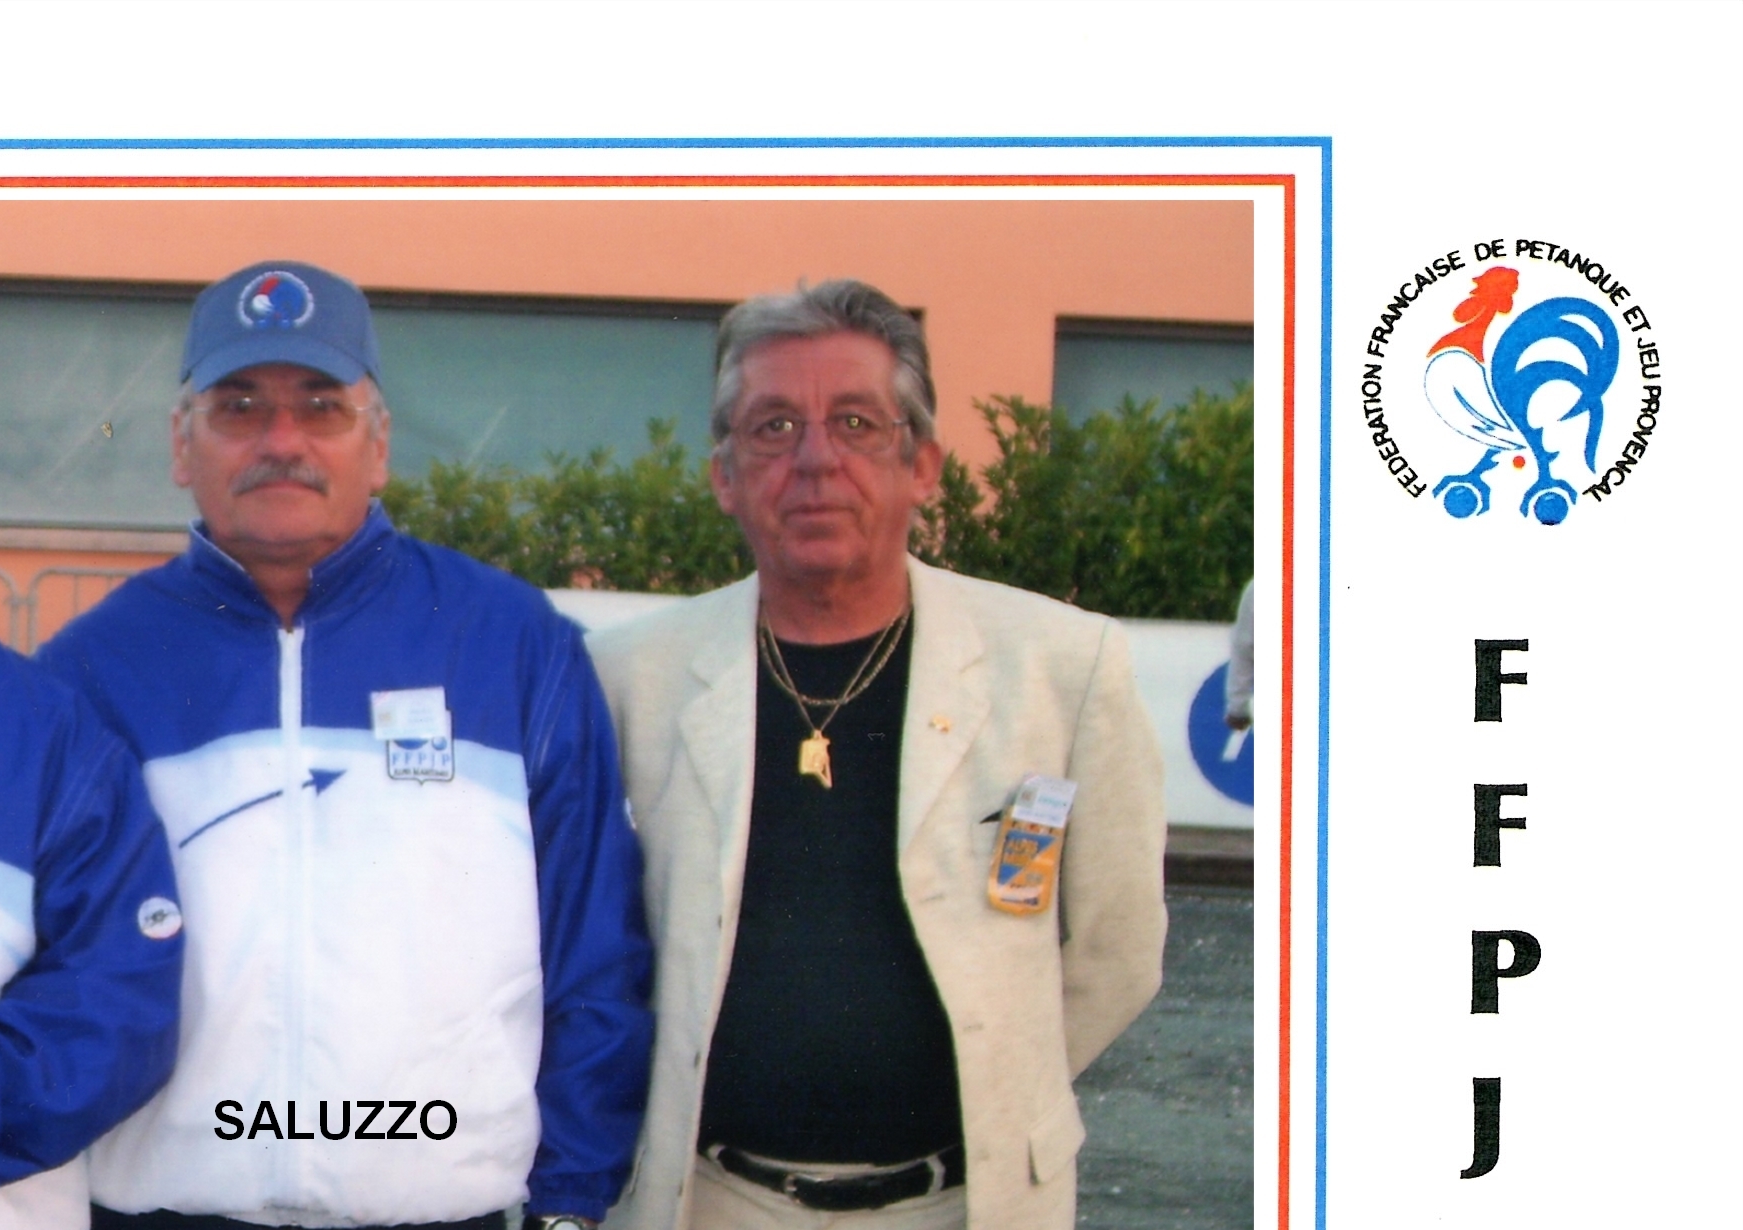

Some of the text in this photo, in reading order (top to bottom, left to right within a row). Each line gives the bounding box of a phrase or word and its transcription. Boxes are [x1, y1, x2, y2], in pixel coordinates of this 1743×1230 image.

[1361, 239, 1662, 502] FEDERATION FRANCAISE DE PETANQUE ET JEU PROVENCAL
